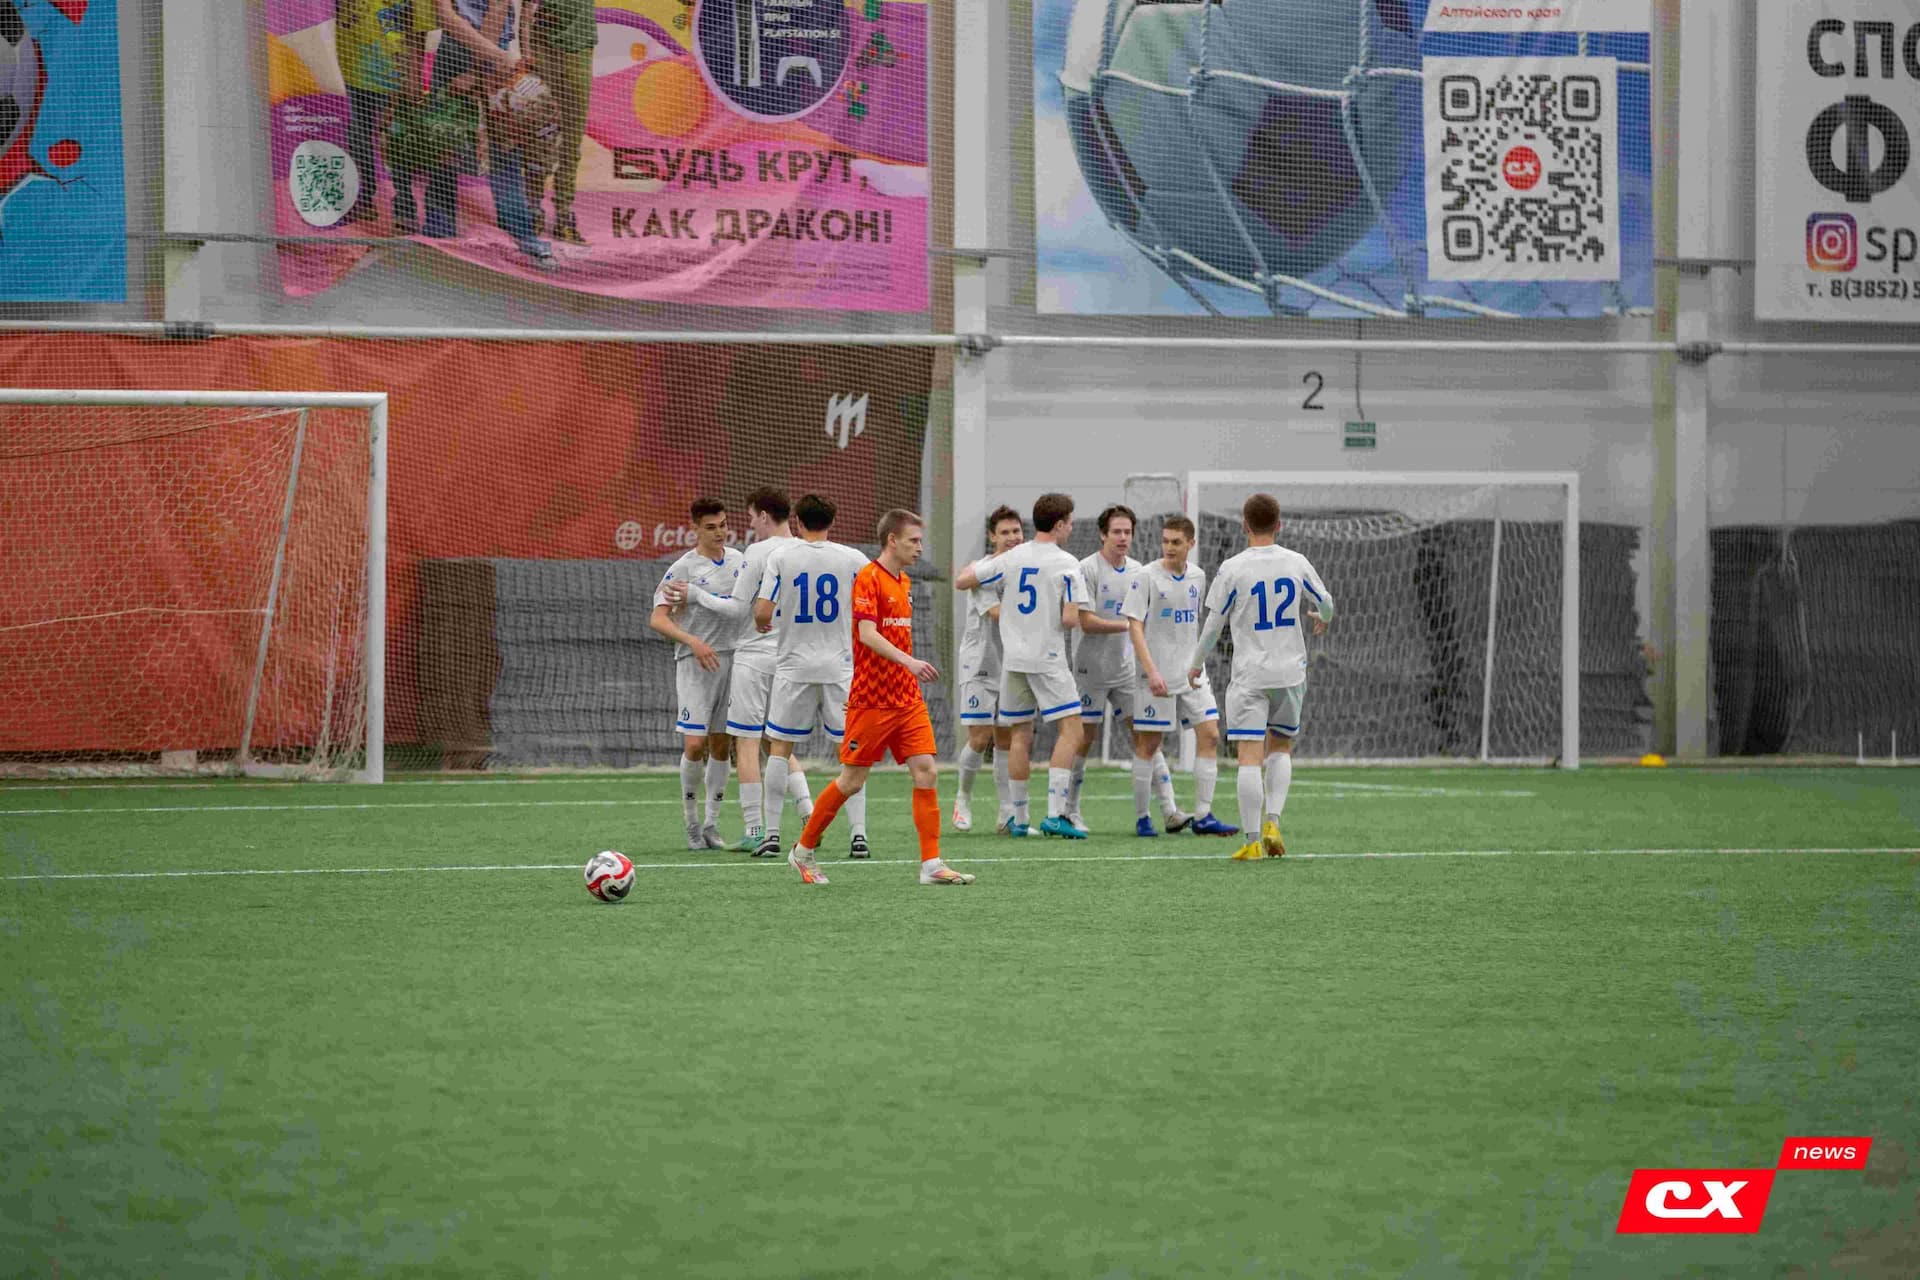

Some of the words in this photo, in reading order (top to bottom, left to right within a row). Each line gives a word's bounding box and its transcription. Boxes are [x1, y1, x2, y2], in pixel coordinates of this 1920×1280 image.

[1440, 6, 1522, 19] Алтайского
[613, 147, 745, 190] БУДЬ
[757, 150, 868, 191] КРУТ,
[1806, 95, 1910, 202] Ф
[612, 207, 699, 239] КАК
[711, 209, 892, 246] ДРАКОН!
[1831, 278, 1907, 300] 8(3852)
[1302, 371, 1324, 410] 2
[794, 572, 839, 624] 18
[1017, 567, 1039, 615] 5
[1251, 577, 1296, 631] 12
